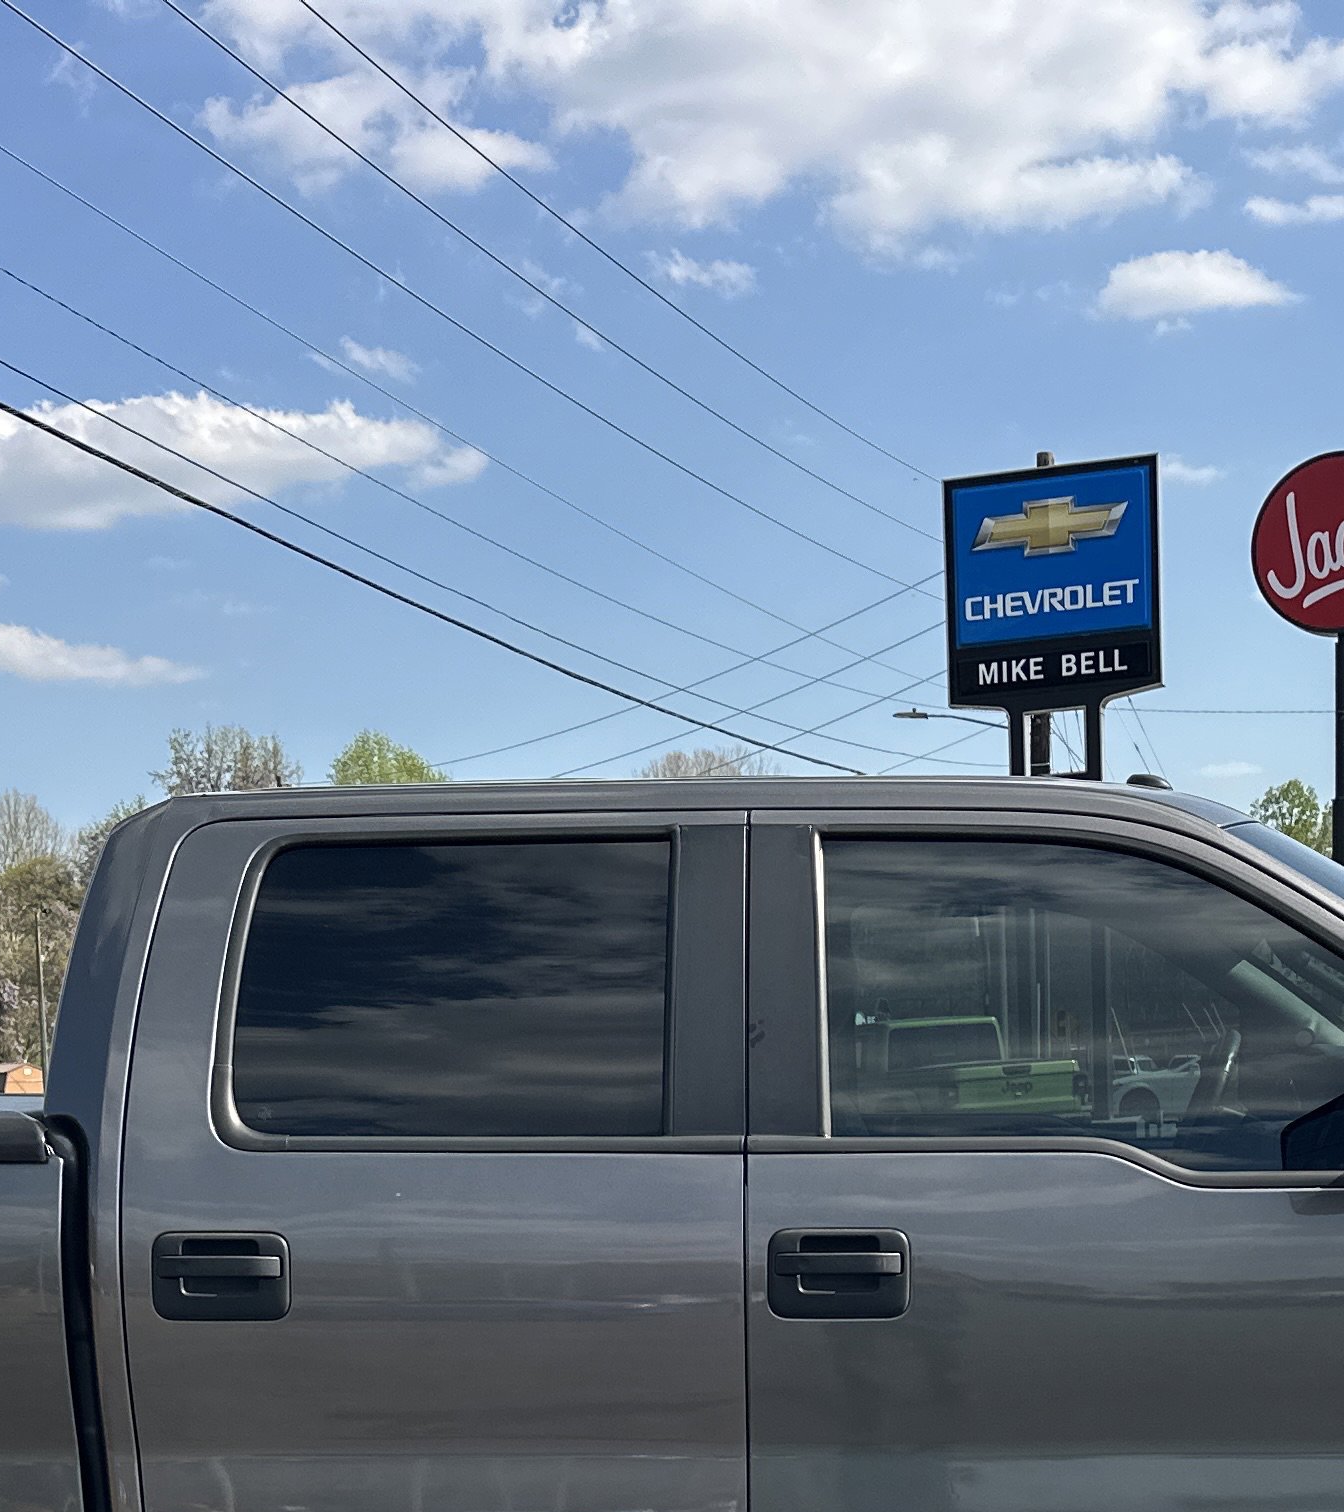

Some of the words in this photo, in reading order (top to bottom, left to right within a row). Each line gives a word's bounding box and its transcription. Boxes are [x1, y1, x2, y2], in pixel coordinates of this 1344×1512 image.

[964, 578, 1140, 621] CHEVROLET
[978, 656, 1045, 686] MIKE
[1061, 648, 1128, 677] BELL
